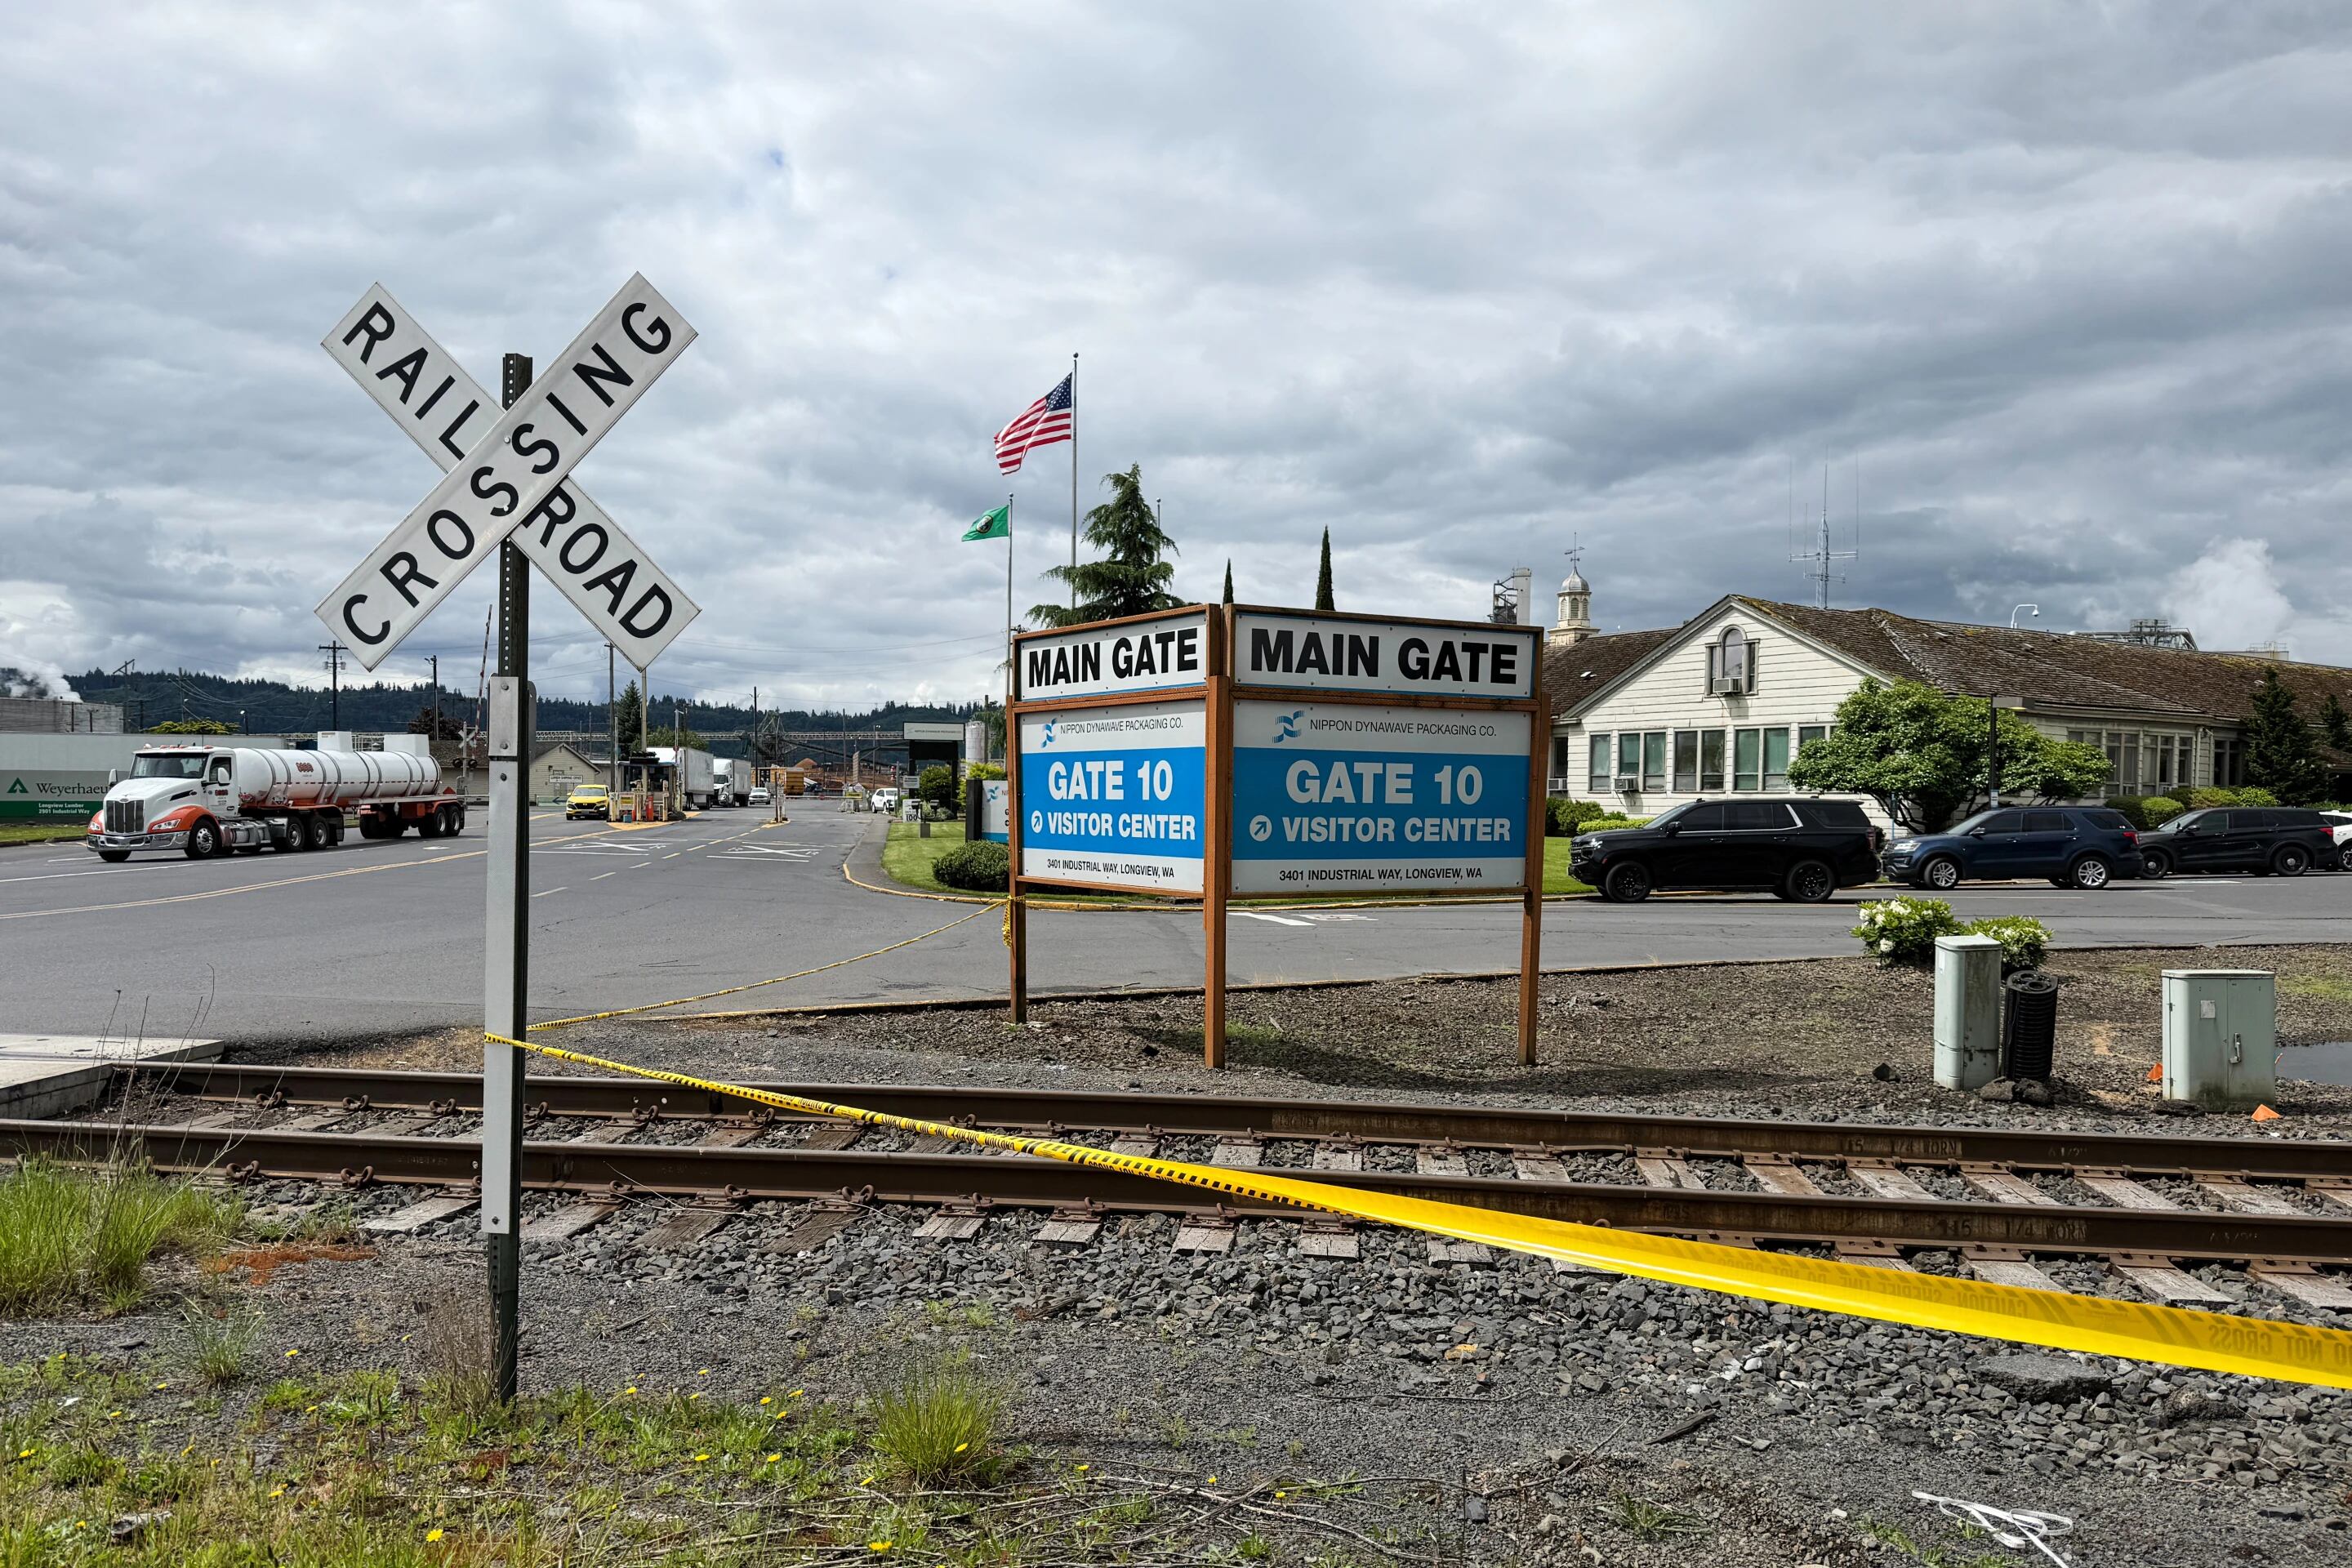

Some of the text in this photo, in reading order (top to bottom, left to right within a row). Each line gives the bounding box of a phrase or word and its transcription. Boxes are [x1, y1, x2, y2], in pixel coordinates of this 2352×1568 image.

[342, 301, 672, 639] RAIL ROAD
[343, 302, 671, 645] CROSSING
[1029, 627, 1197, 688] MAIN GATE
[1251, 628, 1517, 684] MAIN GATE
[1061, 717, 1183, 734] NIPPON DYNAWAVE PACKAGING CO.
[1310, 719, 1497, 737] NIPPON DYNAWAVE PACKAGING CO.
[37, 783, 109, 796] Weyerhaeu
[1049, 760, 1173, 801] GATE 10
[1285, 760, 1483, 805] GATE 10
[1047, 812, 1196, 840] VISITOR CENTER
[1282, 817, 1510, 842] VISITOR CENTER
[1047, 858, 1174, 878] 3401 INDUSTRIAL WAY, LONGVIEW, WA
[1279, 867, 1482, 881] 3401 INDUSTRIAL WAY, LONGVIEW, WA
